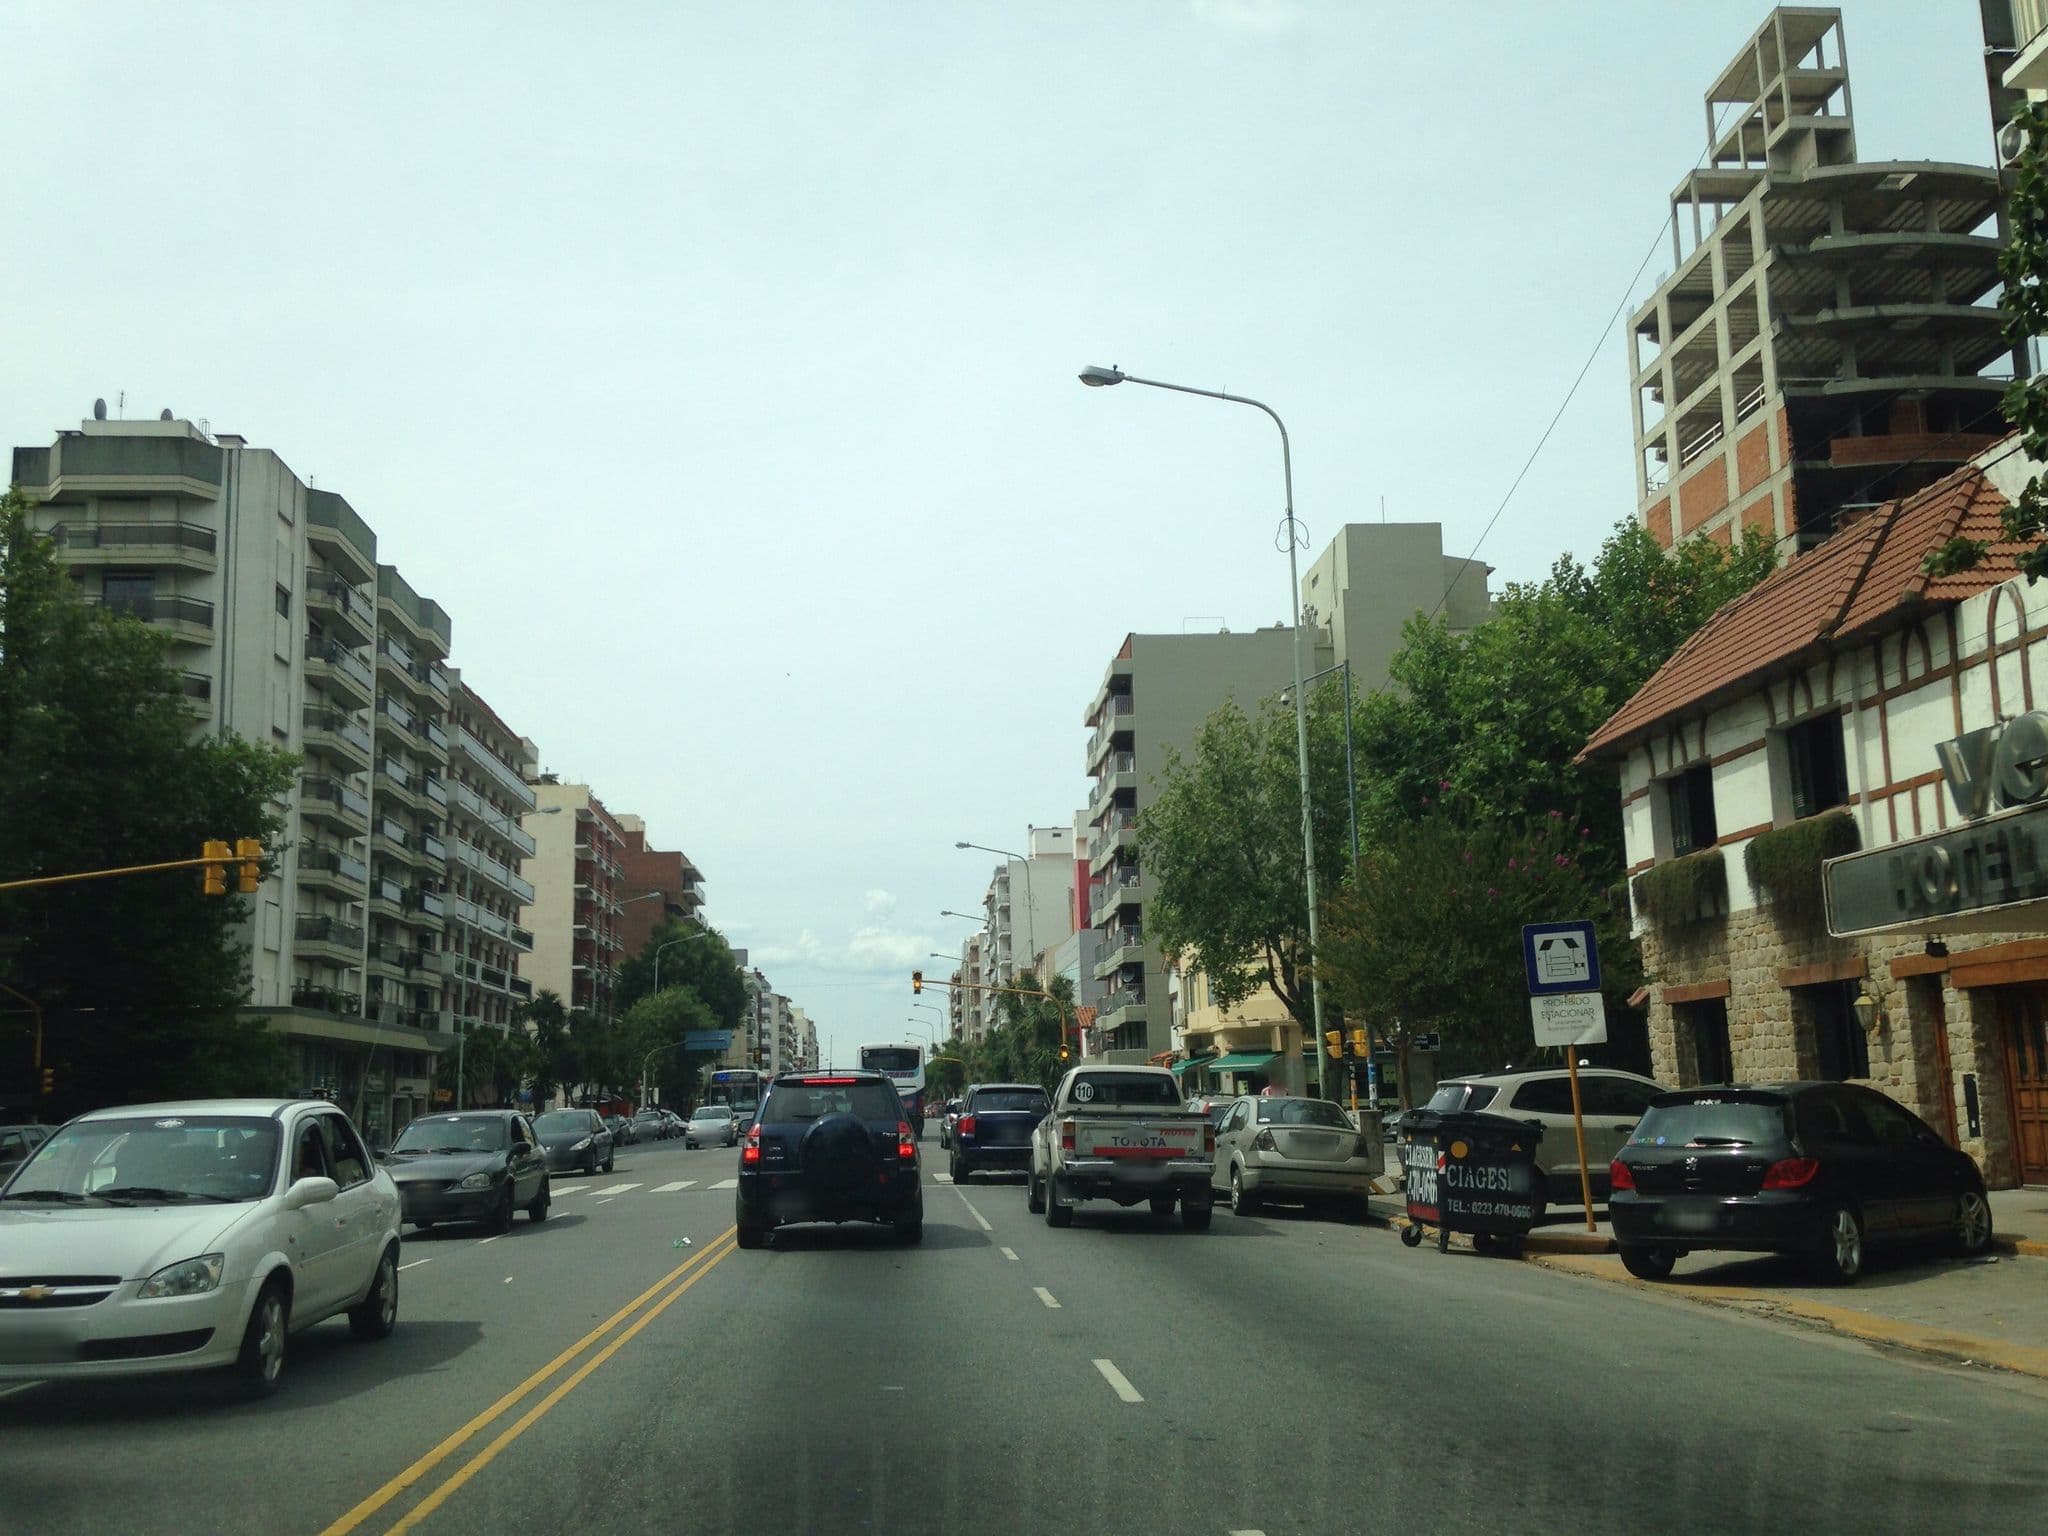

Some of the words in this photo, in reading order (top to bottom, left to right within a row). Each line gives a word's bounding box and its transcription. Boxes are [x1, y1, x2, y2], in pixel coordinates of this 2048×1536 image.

[1888, 826, 2038, 914] HOTEL
[1543, 996, 1590, 1007] PROHIBIDO
[1541, 1007, 1595, 1019] ESTACIONAR
[1077, 1086, 1092, 1099] 110
[1112, 1136, 1166, 1147] TOOTA
[1472, 1202, 1493, 1215] 0223
